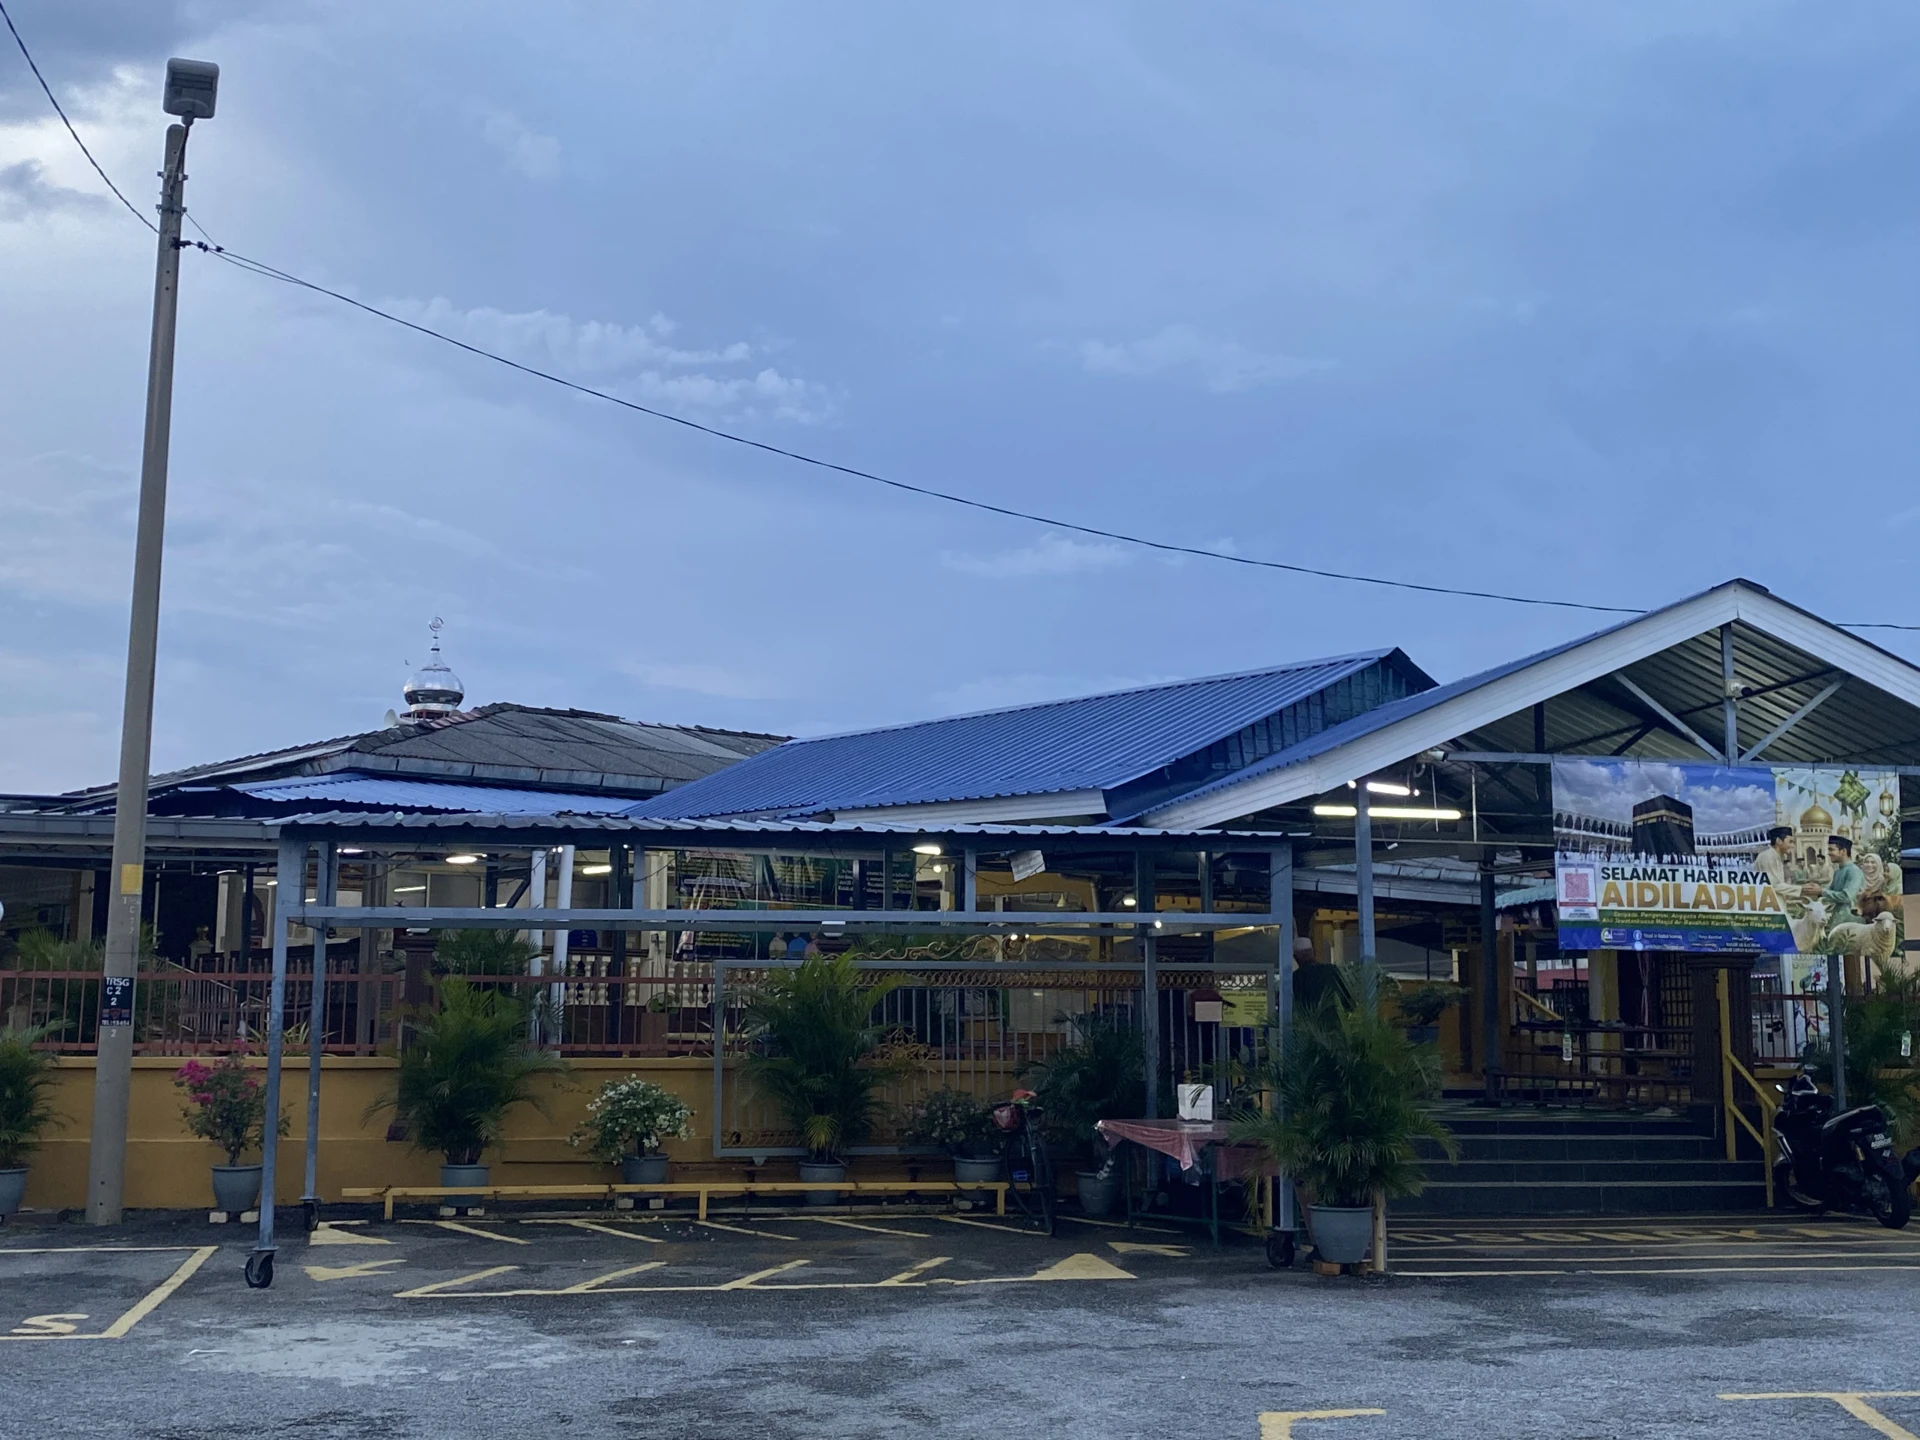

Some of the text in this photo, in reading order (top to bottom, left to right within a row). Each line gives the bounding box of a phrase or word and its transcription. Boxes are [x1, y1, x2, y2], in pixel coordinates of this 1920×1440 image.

[1601, 867, 1771, 885] SELAMAT HARI RAYA
[106, 986, 122, 995] C 2
[110, 997, 117, 1006] 2
[110, 1029, 117, 1038] 2
